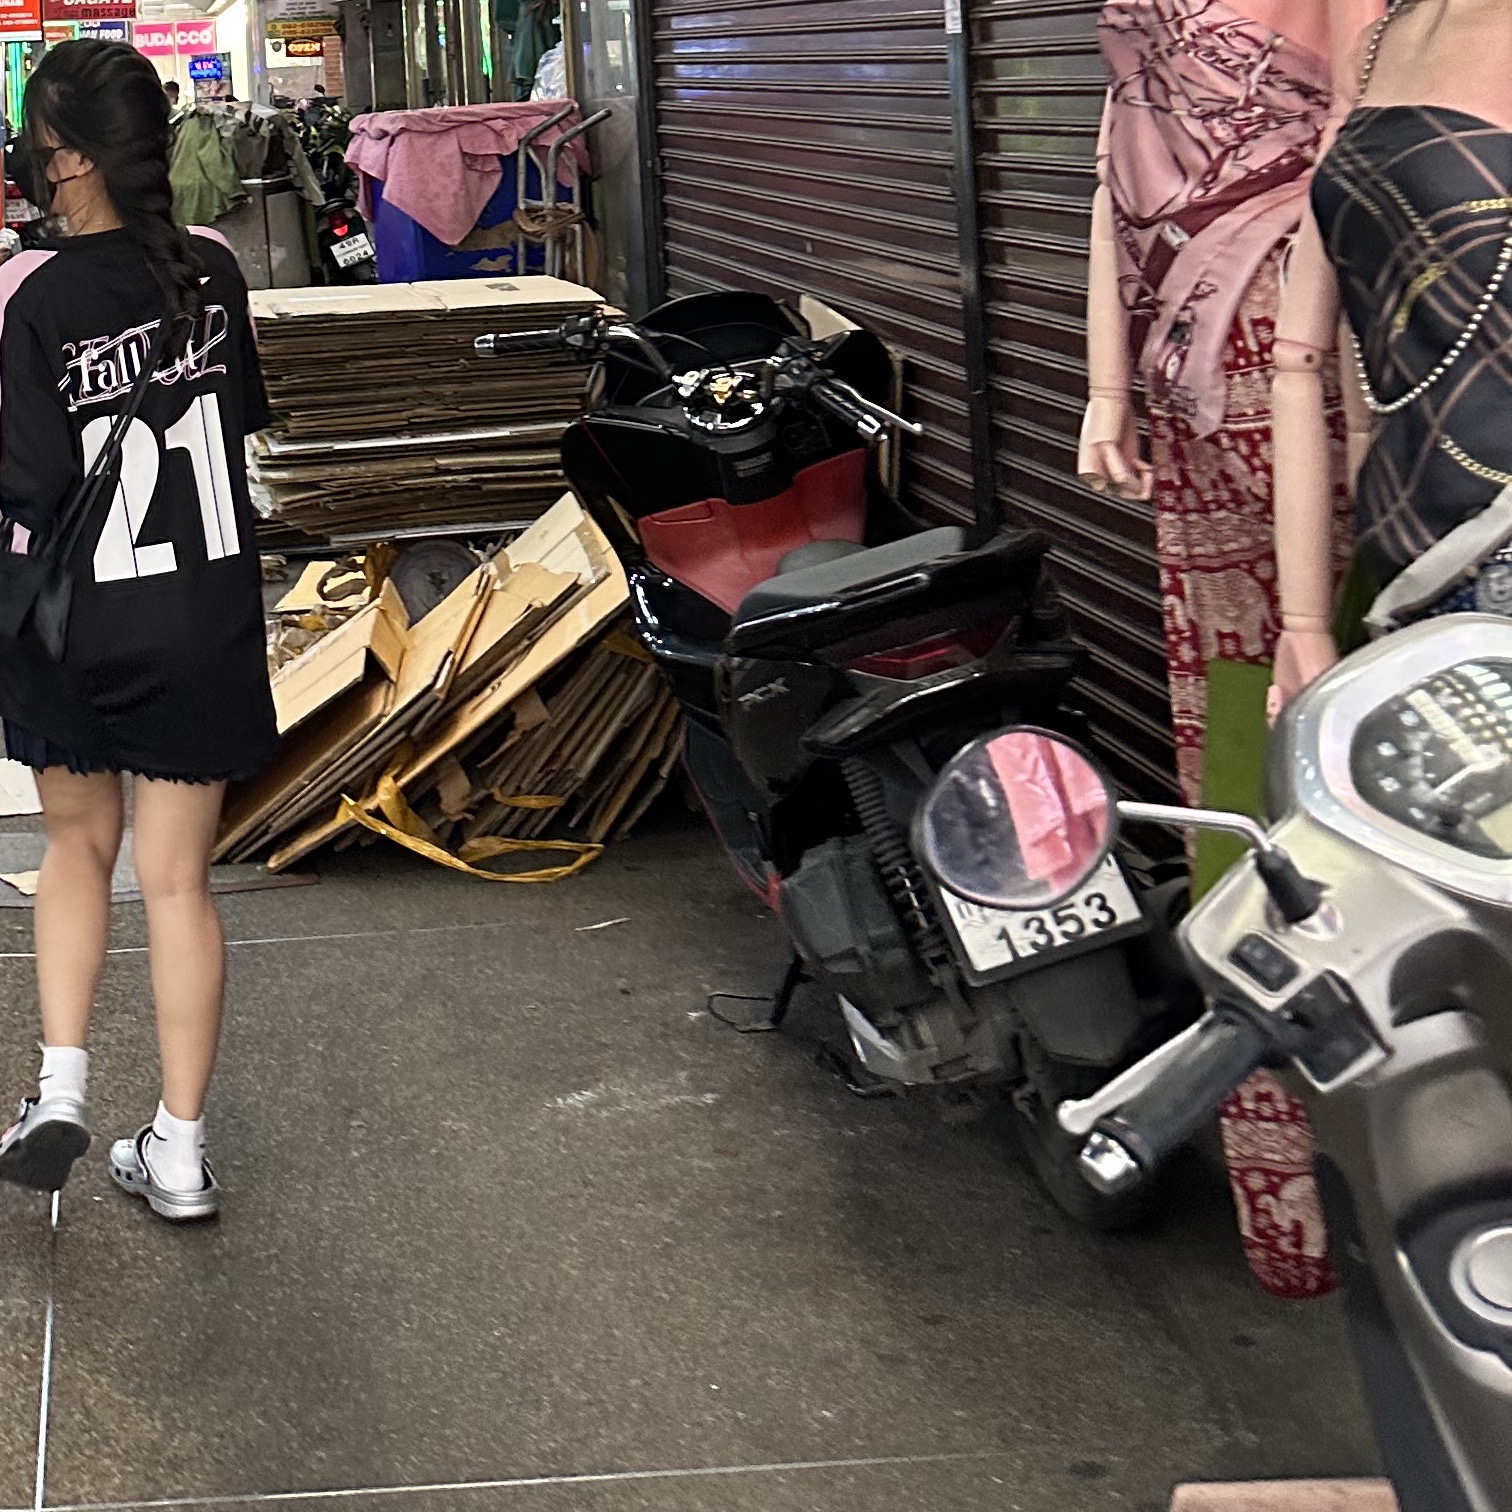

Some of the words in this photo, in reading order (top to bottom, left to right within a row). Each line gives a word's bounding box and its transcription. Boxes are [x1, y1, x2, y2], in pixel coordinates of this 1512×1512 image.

[288, 42, 321, 52] OPEN
[81, 392, 241, 583] 21
[996, 892, 1118, 961] 1353
